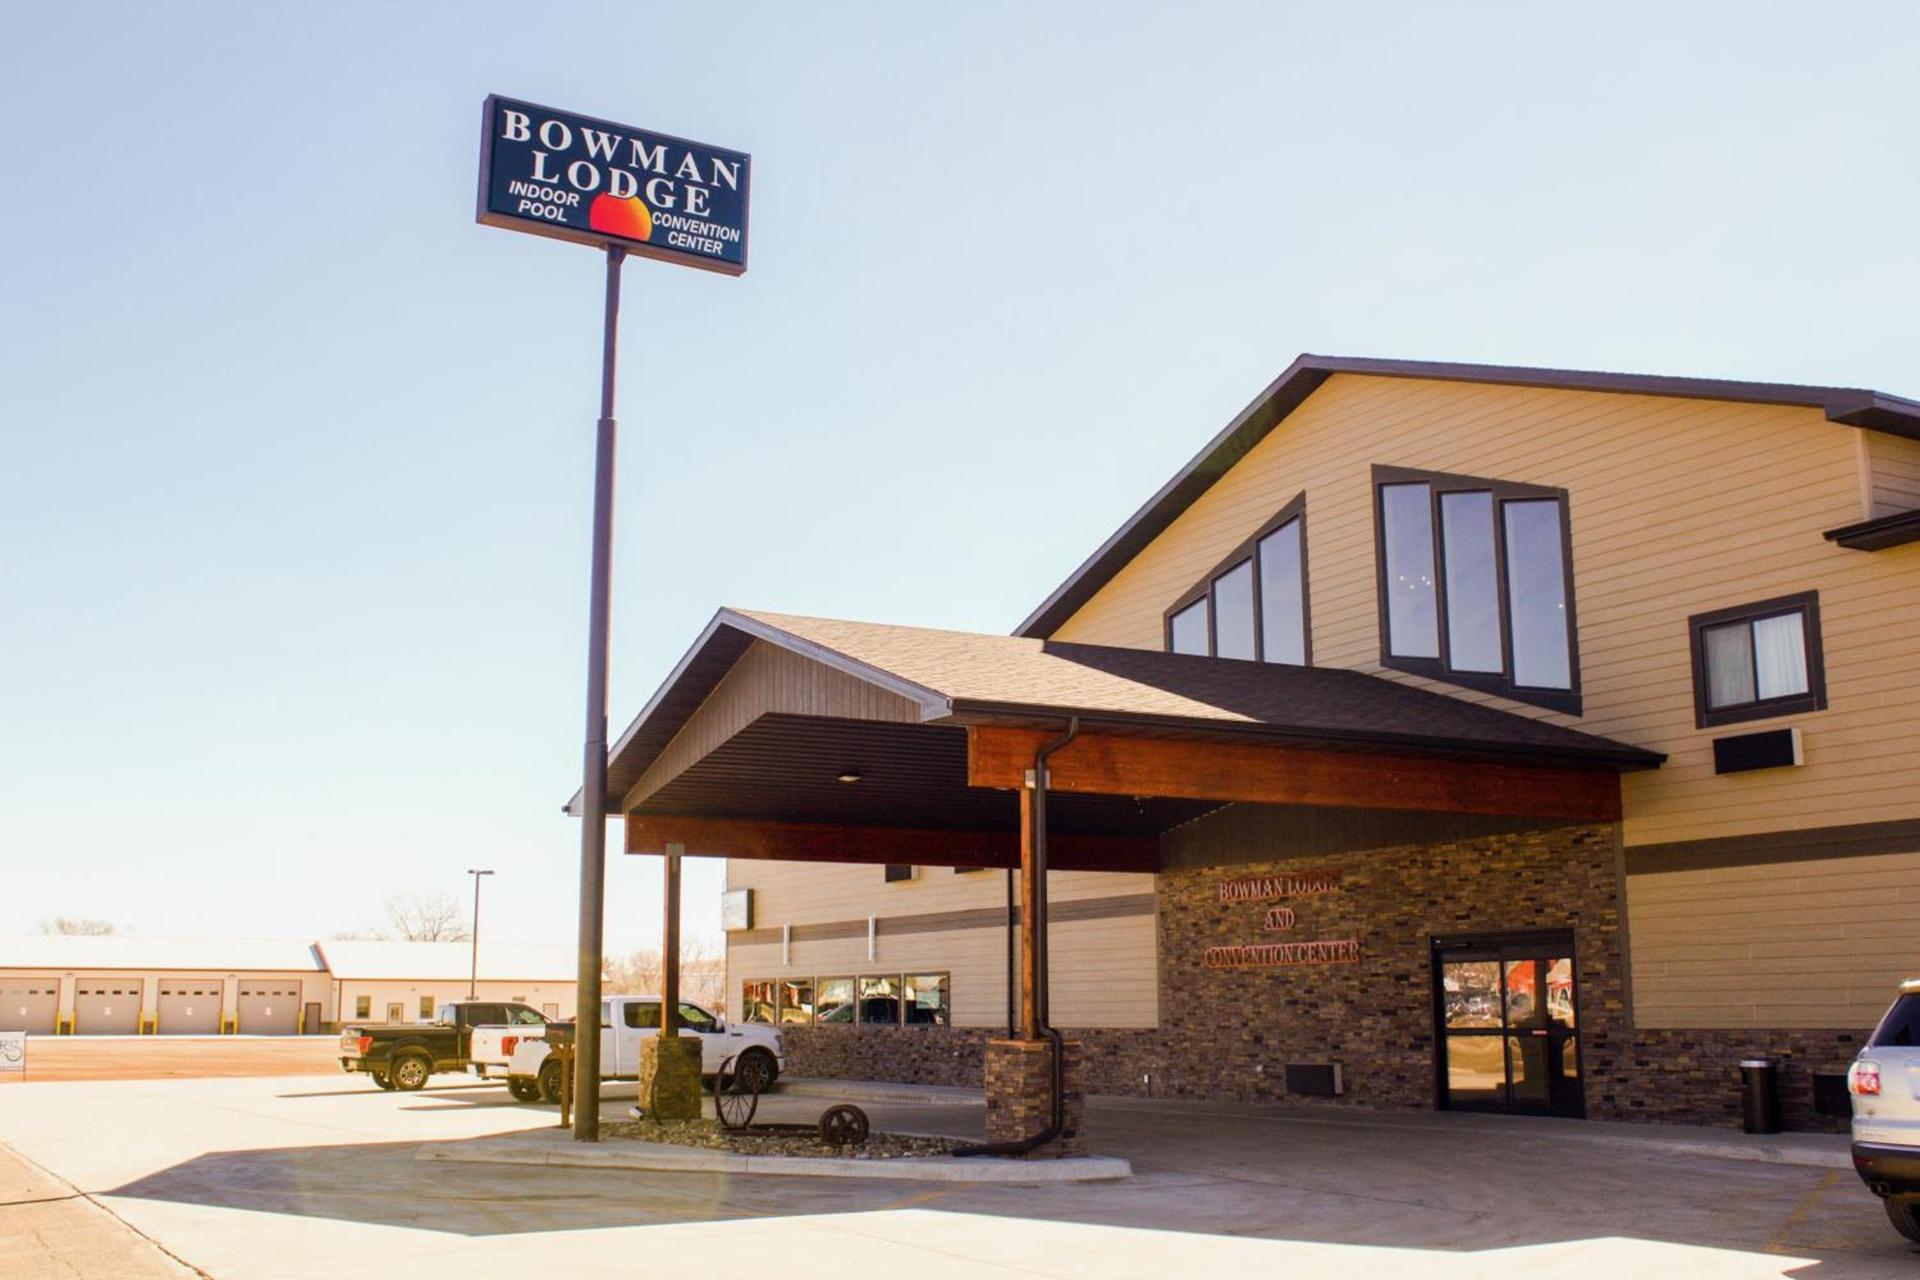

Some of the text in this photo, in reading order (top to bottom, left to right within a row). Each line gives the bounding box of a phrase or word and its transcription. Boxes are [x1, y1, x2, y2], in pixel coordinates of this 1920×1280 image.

[501, 109, 741, 191] BOWMAN
[509, 180, 580, 207] INDOOR
[530, 150, 711, 217] LODGE
[518, 200, 568, 222] POOL
[652, 211, 740, 242] CONVENTION
[668, 230, 723, 255] CENTER
[1218, 877, 1283, 900] BOWMAN
[1264, 908, 1295, 930] AND
[1204, 940, 1359, 968] CONVENTION CENTER
